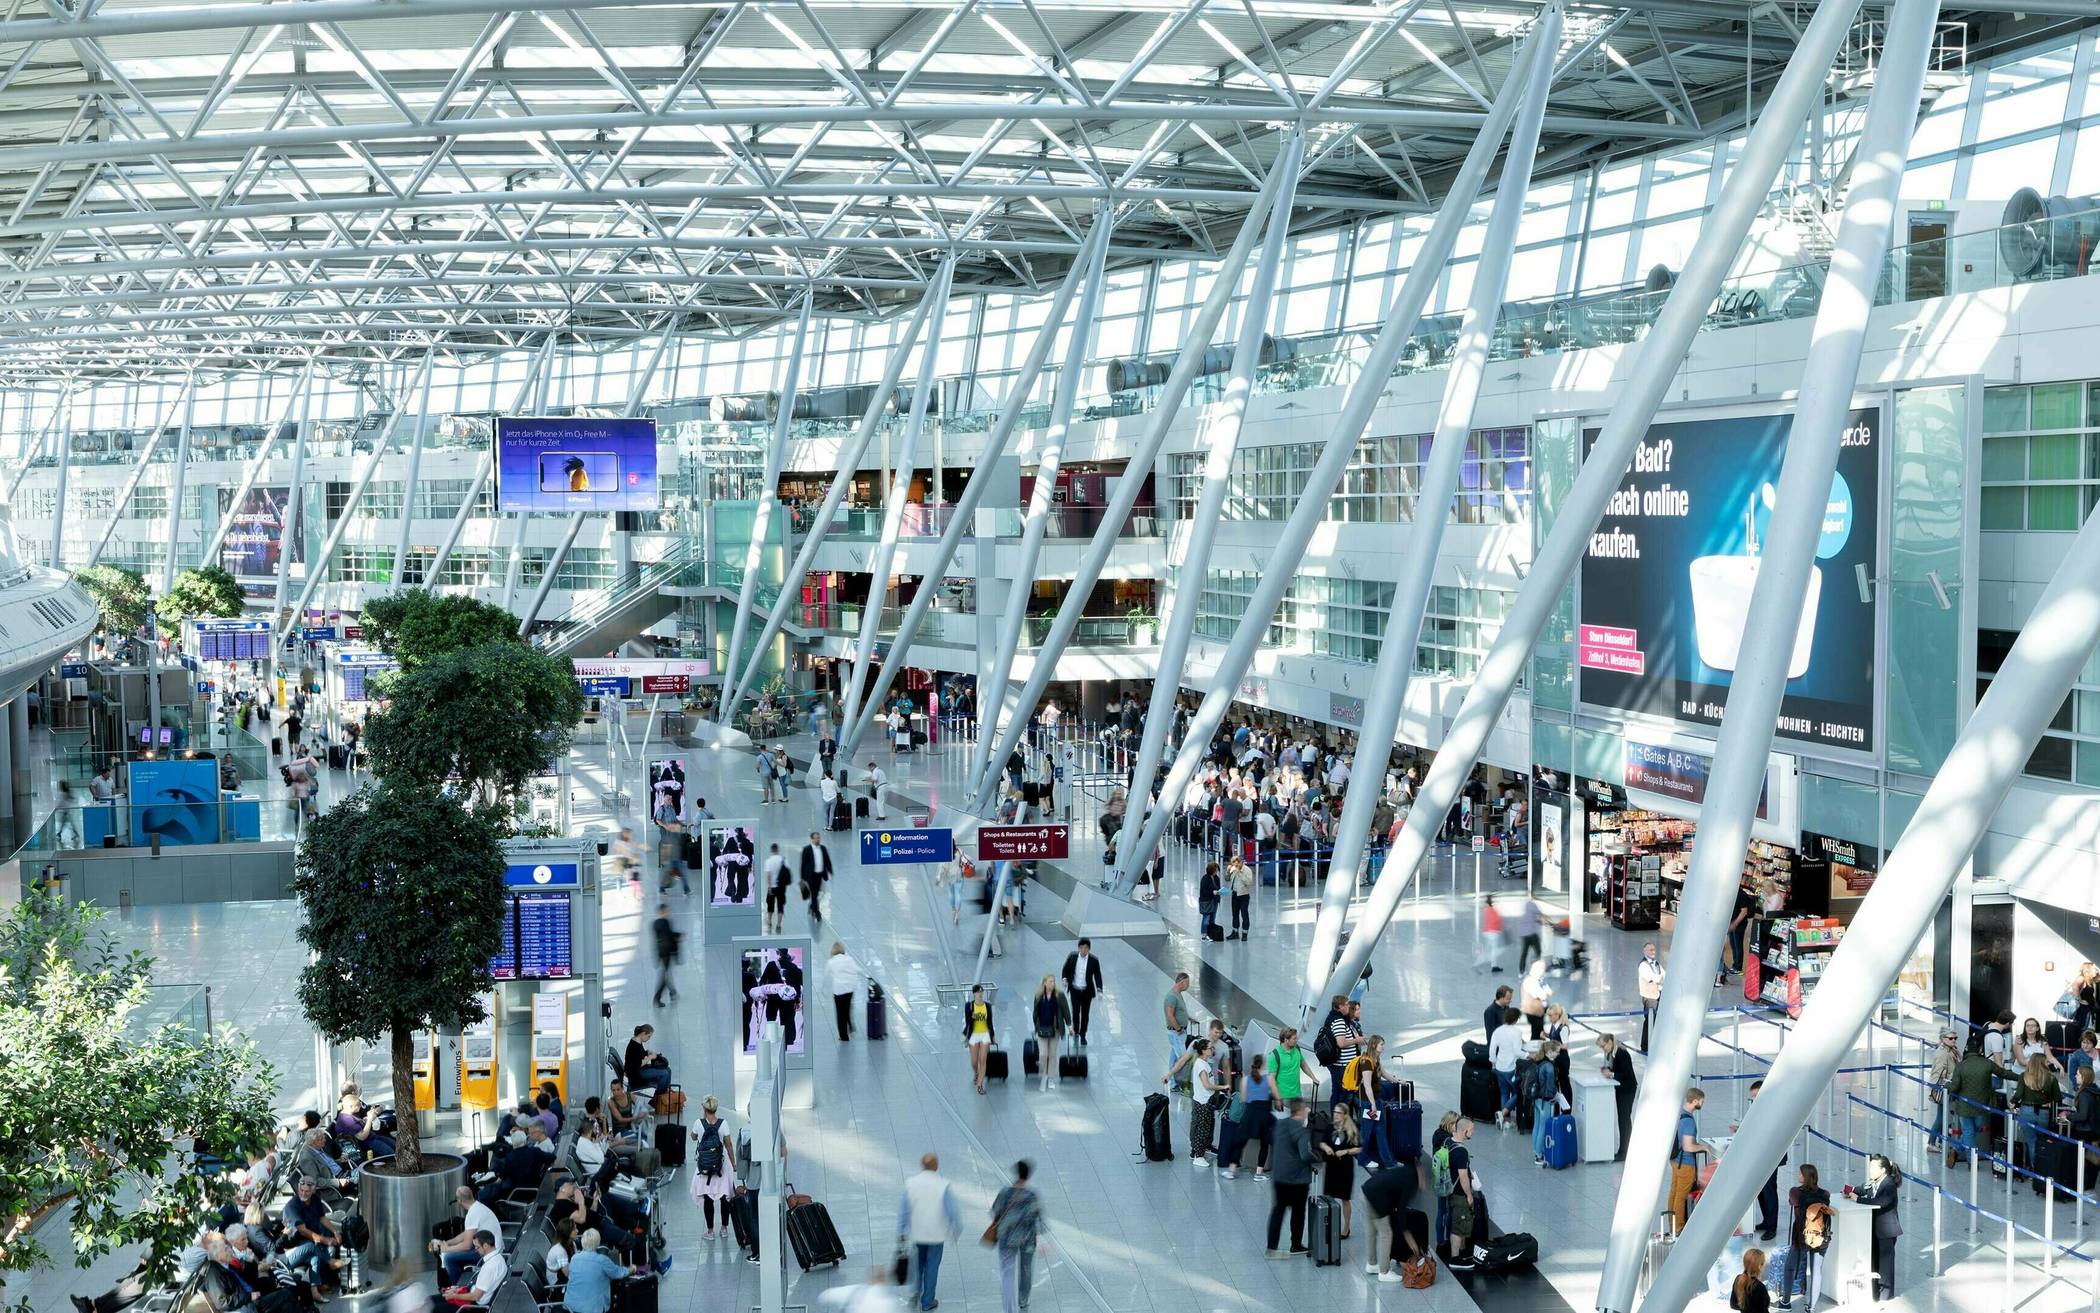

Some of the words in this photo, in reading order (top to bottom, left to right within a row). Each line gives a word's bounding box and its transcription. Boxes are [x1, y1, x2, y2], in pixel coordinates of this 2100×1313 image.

[1840, 422, 1870, 447] er.de
[1636, 439, 1673, 472] Bad?
[1644, 484, 1689, 516] online
[1589, 526, 1640, 558] kaufen.
[76, 666, 87, 674] 10
[1682, 700, 1697, 715] BAD
[1704, 702, 1726, 719] KÜCH
[1777, 716, 1811, 733] WOHNEN
[1821, 722, 1864, 742] LEUCHTEN
[1644, 747, 1666, 765] Gates
[1643, 772, 1658, 785] Shops
[1659, 776, 1663, 785] &
[1664, 776, 1694, 794] Restaurants
[1821, 837, 1856, 857] WHSmith
[1835, 854, 1855, 865] EXPRESS
